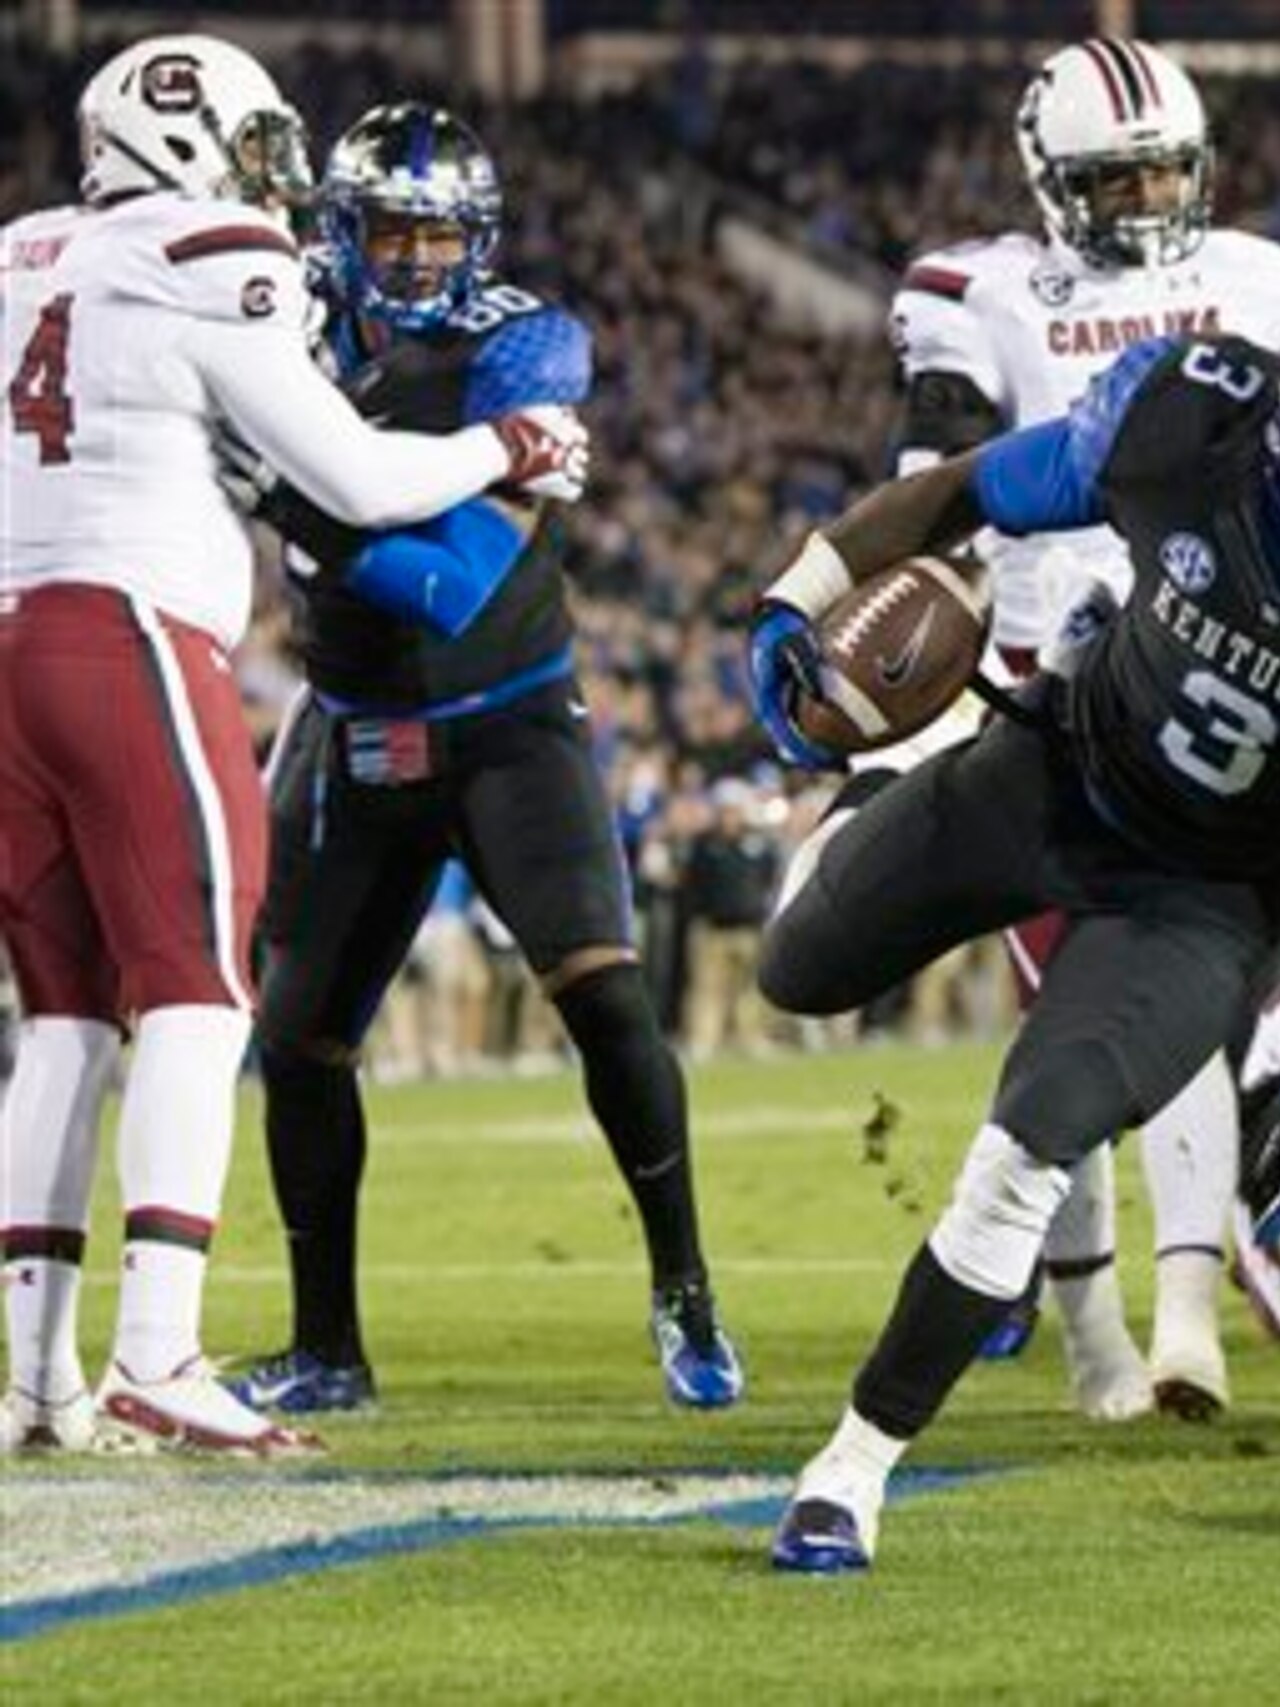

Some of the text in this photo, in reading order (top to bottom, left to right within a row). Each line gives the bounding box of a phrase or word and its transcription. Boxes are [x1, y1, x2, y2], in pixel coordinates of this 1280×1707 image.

[9, 292, 75, 466] 4
[1182, 344, 1264, 401] 3
[1157, 670, 1279, 795] 3
